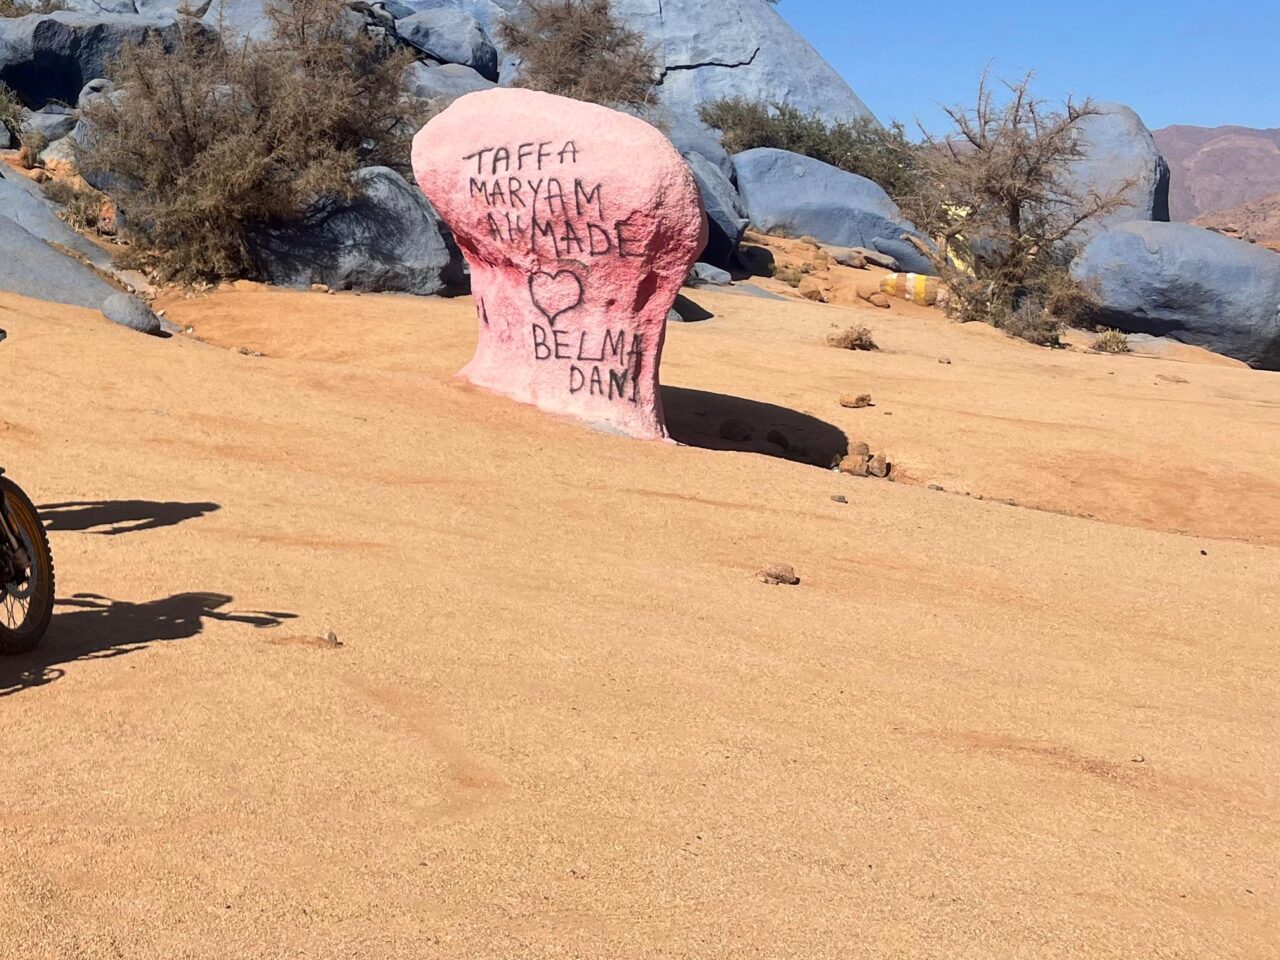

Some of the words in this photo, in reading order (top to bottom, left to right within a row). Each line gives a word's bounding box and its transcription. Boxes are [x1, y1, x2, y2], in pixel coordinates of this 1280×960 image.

[462, 141, 579, 174] TAFFA
[469, 176, 605, 222] MARYAM
[532, 323, 644, 367] BELMA
[569, 364, 639, 403] DANI
